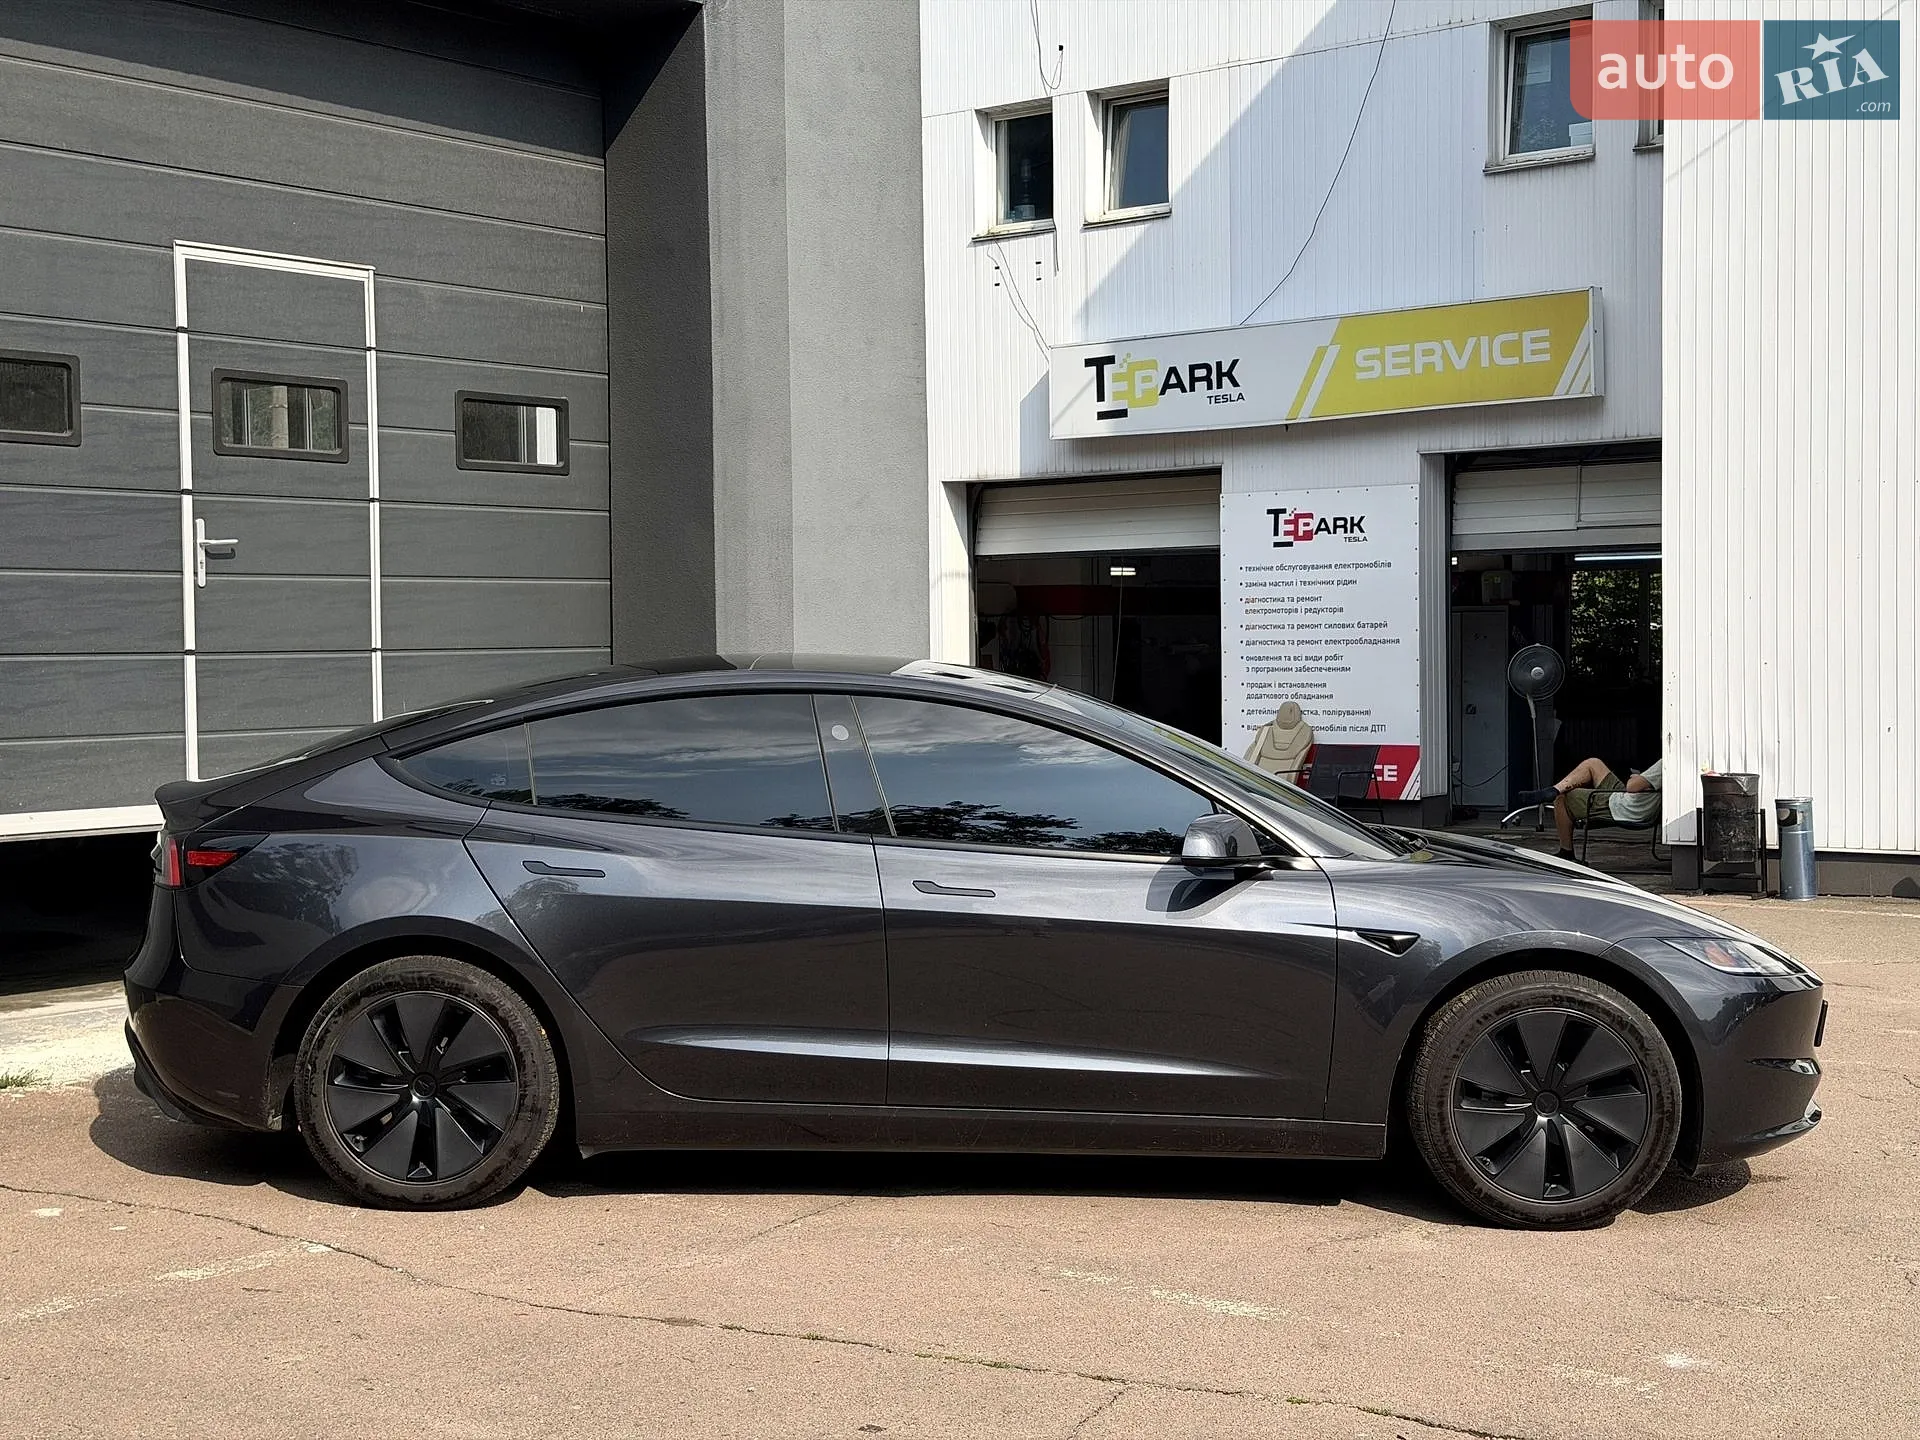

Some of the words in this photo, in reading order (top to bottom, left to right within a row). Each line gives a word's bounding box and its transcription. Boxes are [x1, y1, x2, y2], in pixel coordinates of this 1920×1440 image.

[1355, 328, 1551, 380] SERVICE
[1206, 392, 1245, 405] TESLA
[1245, 564, 1273, 573] технічне
[1276, 564, 1332, 573] обслуговування
[1334, 560, 1391, 570] електромобілів
[1245, 580, 1266, 588] заміна
[1300, 578, 1335, 587] технічних
[1337, 578, 1357, 587] рідин
[1245, 596, 1285, 604] діагностика
[1297, 596, 1322, 605] ремонт
[1245, 606, 1298, 615] електромоторів
[1305, 605, 1343, 614] редукторів
[1245, 622, 1285, 631] діагностика
[1297, 623, 1322, 632] ремонт
[1324, 622, 1355, 630] силових
[1357, 621, 1387, 630] батарей
[1245, 638, 1285, 647] діагностика
[1297, 640, 1322, 648] ремонт
[1324, 637, 1400, 646] електрообладнання
[1293, 654, 1303, 662] всі
[1305, 655, 1322, 663] види
[1325, 654, 1343, 663] робіт
[1251, 667, 1292, 675] програмним
[1247, 682, 1272, 690] продаж
[1278, 681, 1326, 689] встановлення
[1246, 693, 1289, 701] додаткового
[1291, 692, 1333, 700] обладнання
[1349, 724, 1368, 732] після
[1371, 725, 1386, 734] ДТП
